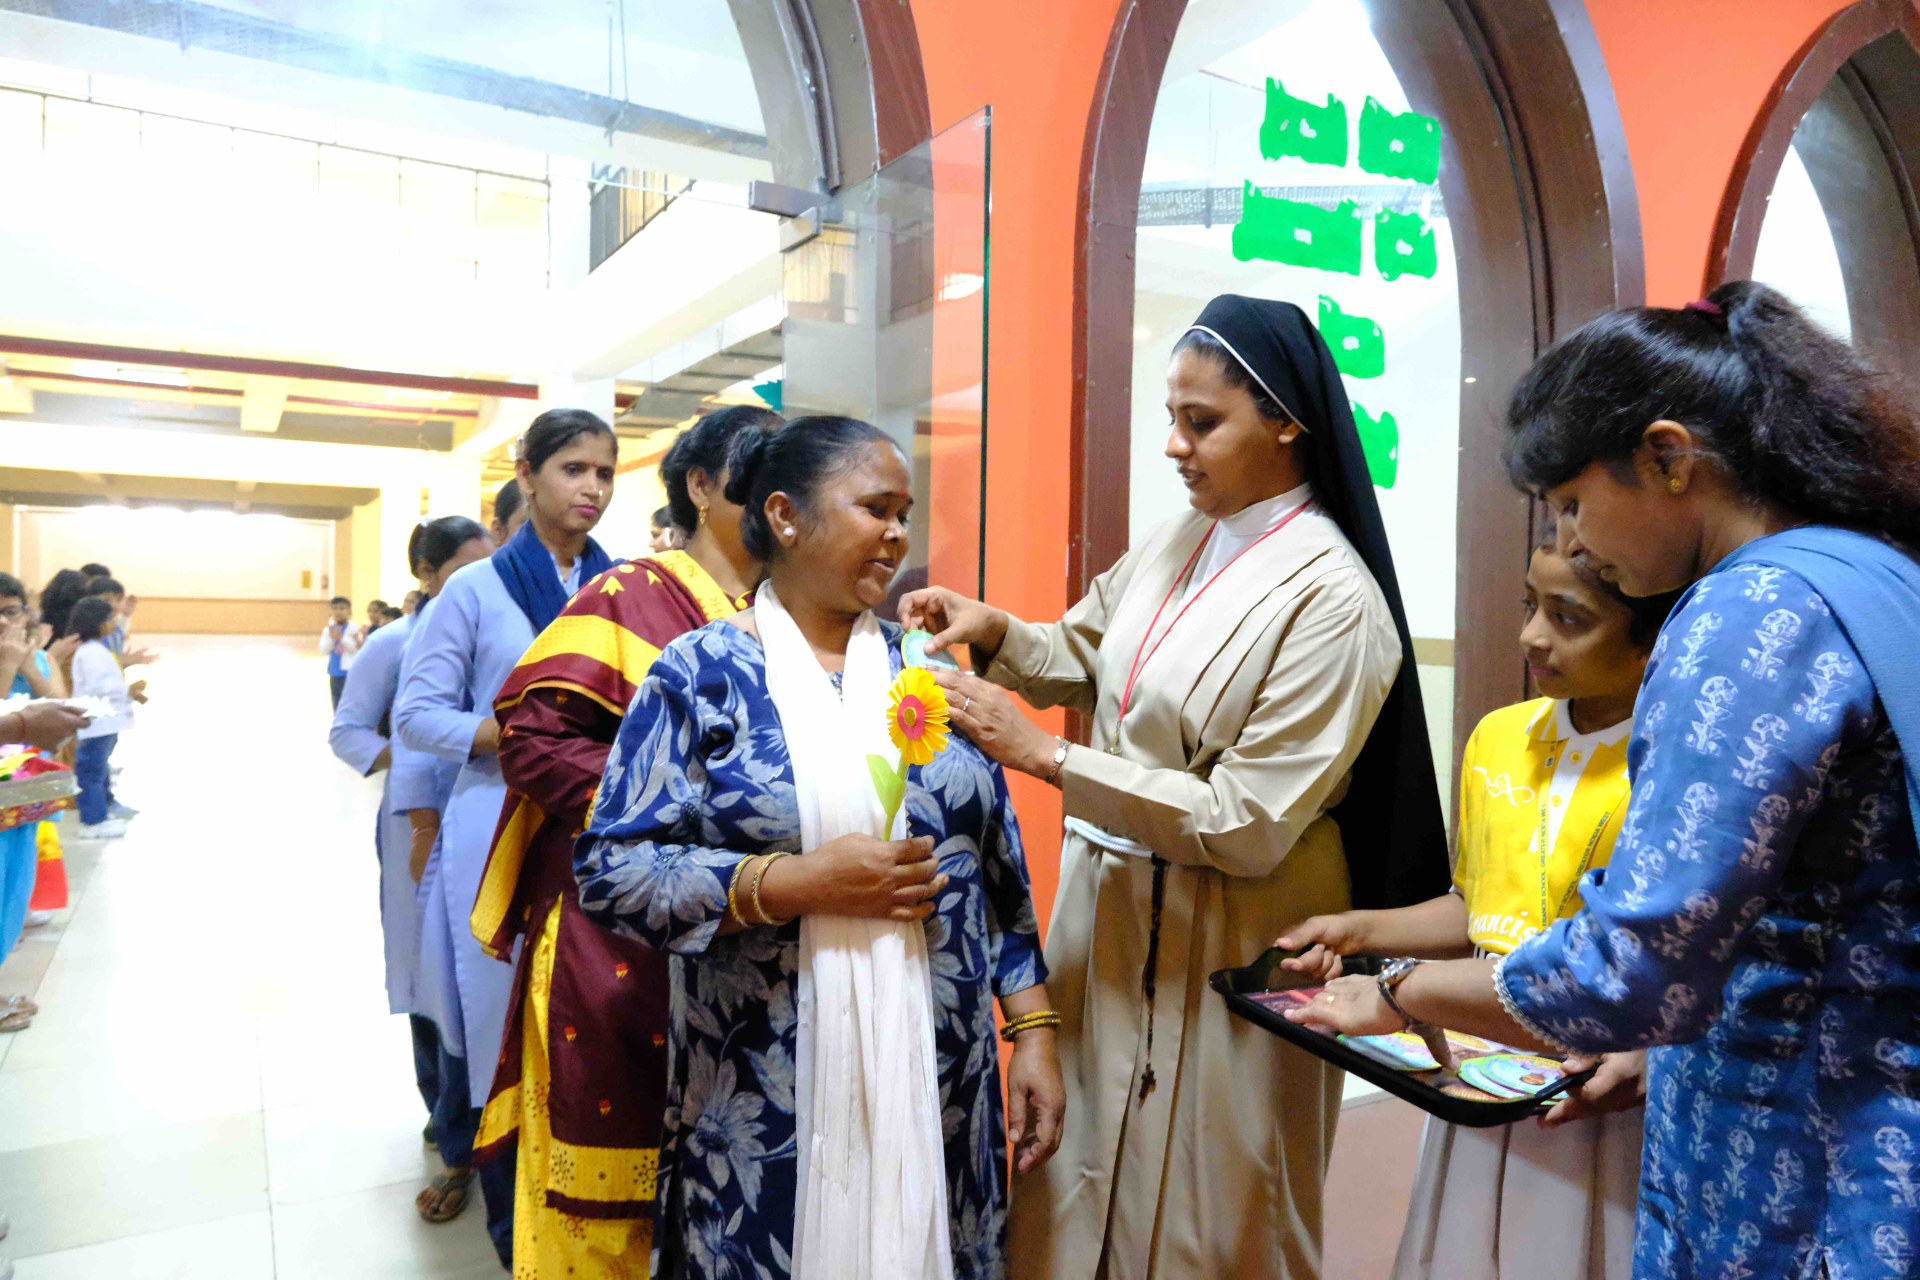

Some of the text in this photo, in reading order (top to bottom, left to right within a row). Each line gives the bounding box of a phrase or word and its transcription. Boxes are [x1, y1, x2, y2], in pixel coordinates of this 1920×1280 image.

[1576, 848, 1590, 876] GREATER
[1589, 828, 1600, 846] NOIDA
[1598, 811, 1610, 827] WEST
